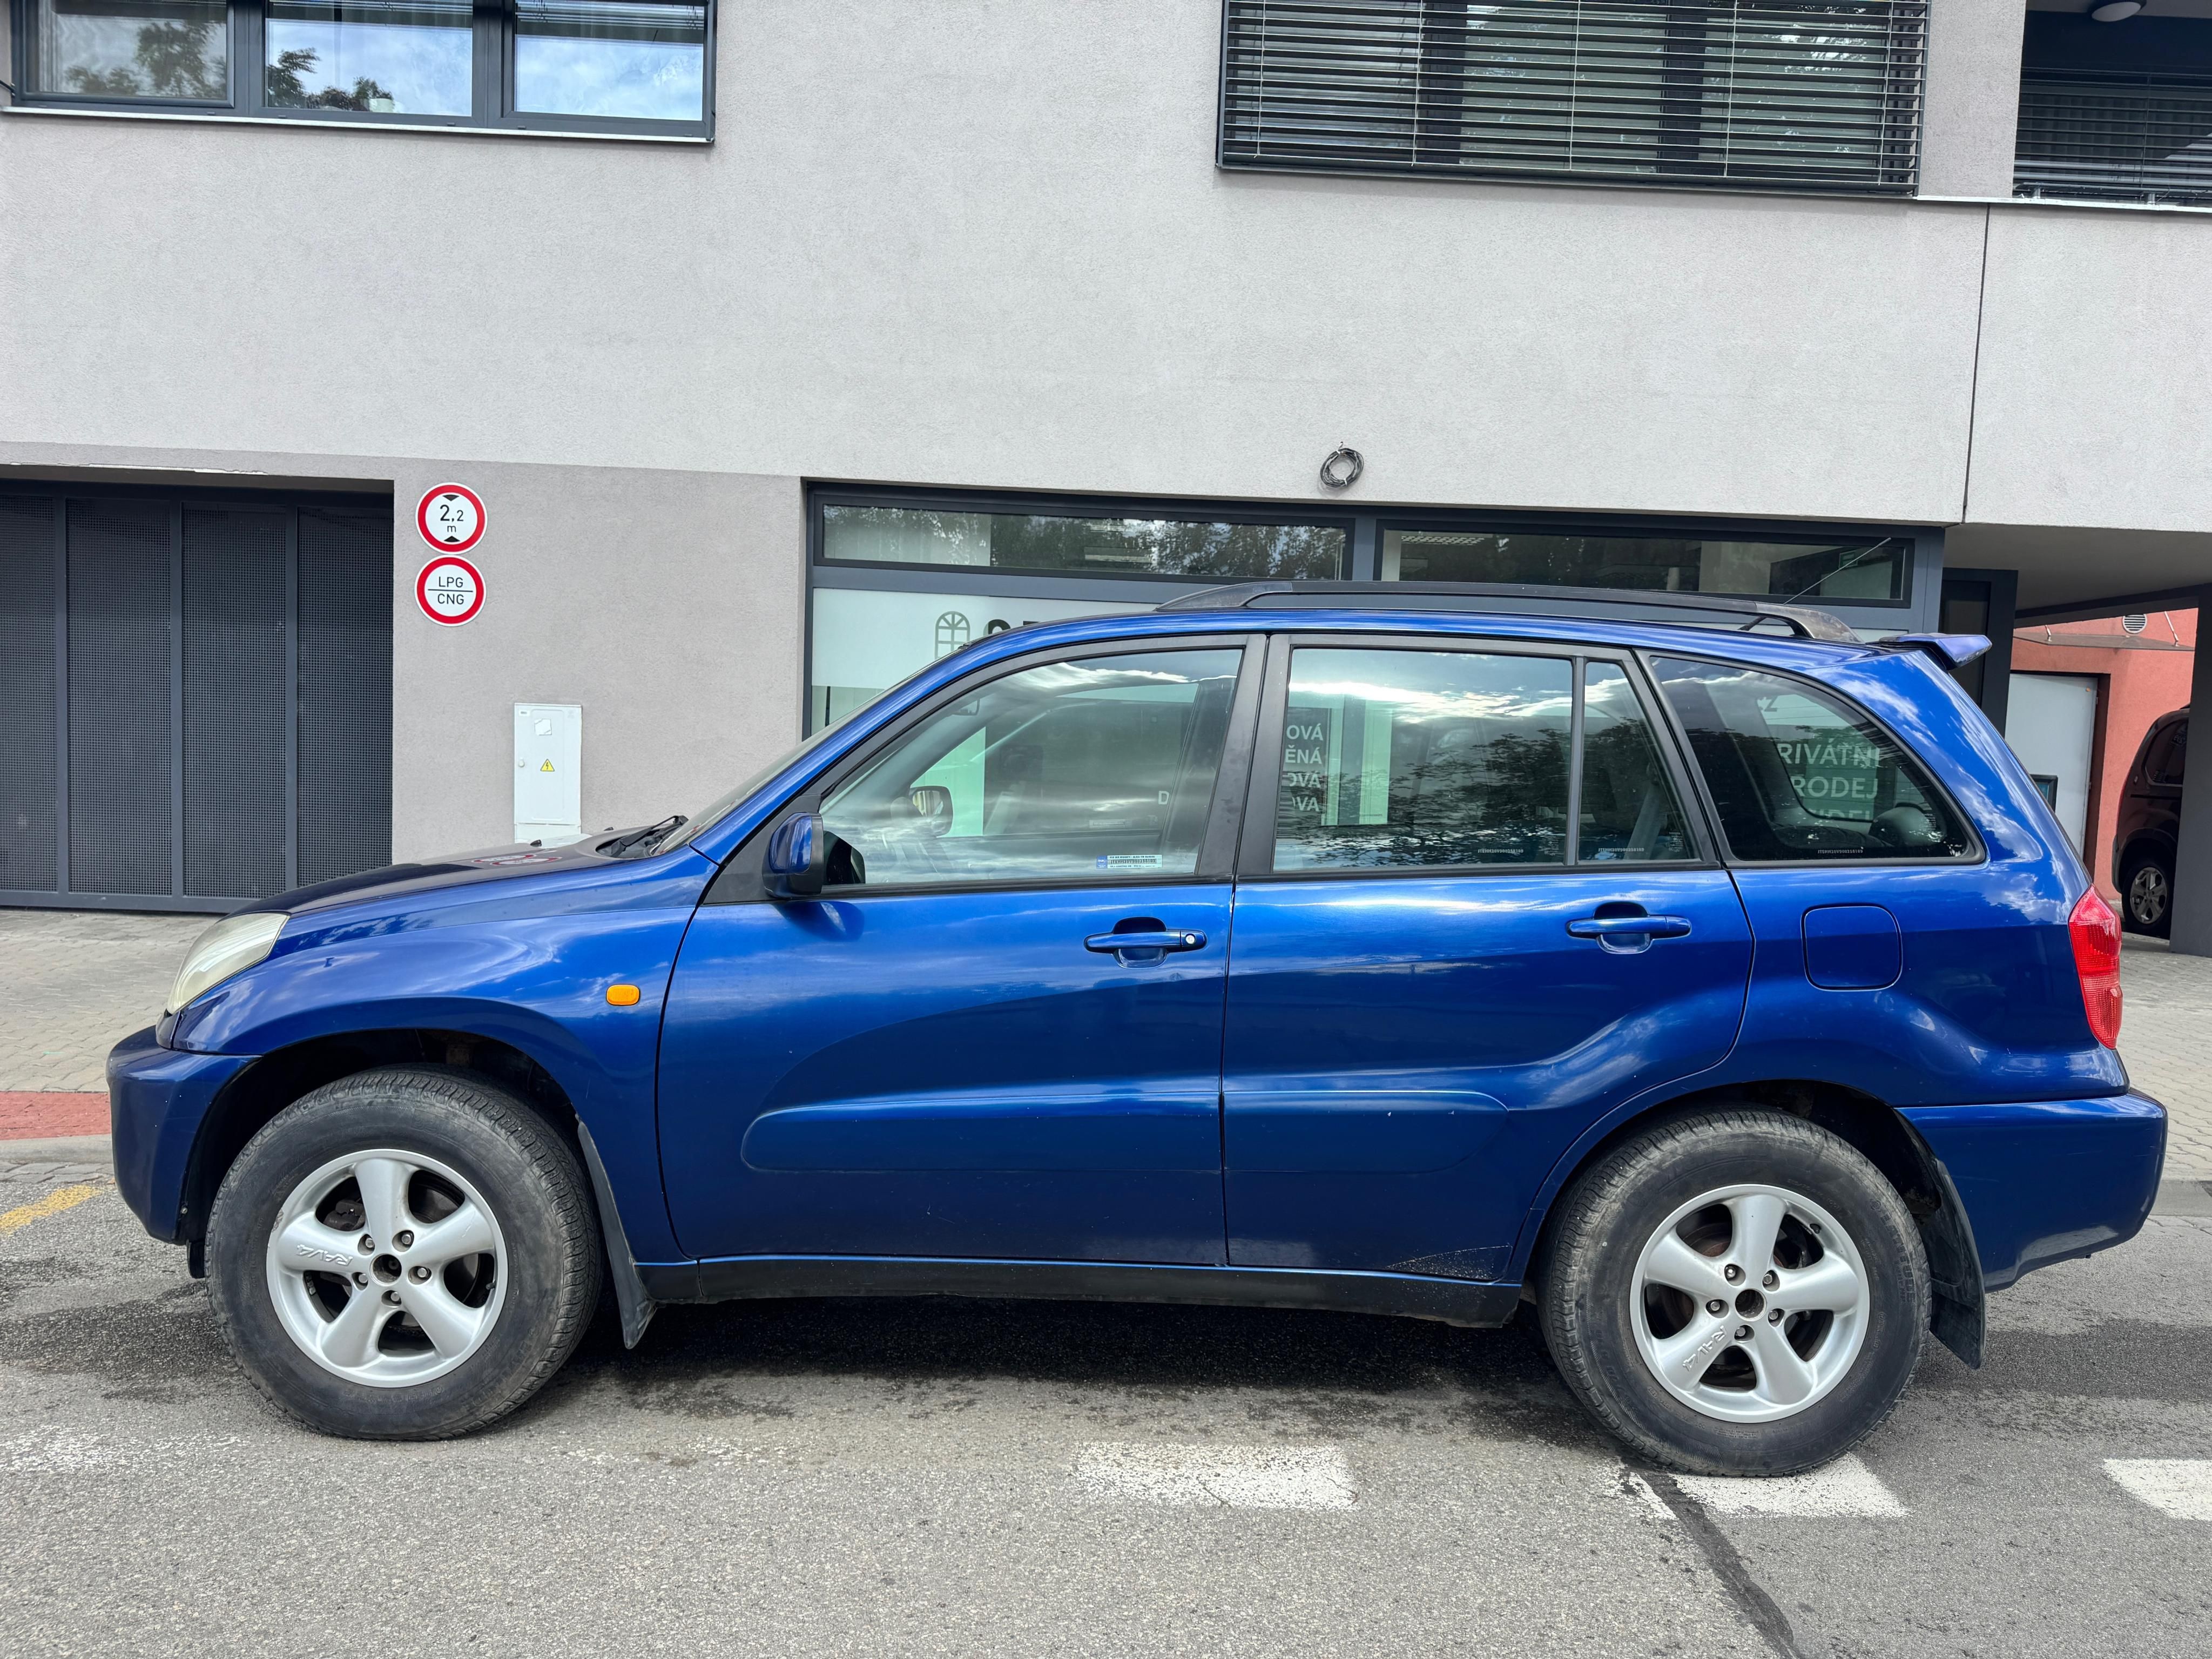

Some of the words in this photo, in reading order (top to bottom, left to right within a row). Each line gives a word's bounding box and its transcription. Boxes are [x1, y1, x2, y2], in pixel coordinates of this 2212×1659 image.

[440, 504, 464, 522] 2,2
[438, 576, 463, 588] LPG
[437, 593, 464, 605] CNG
[1286, 723, 1324, 741] OVÁ
[1285, 745, 1323, 764] ĚNÁ
[1158, 790, 1170, 805] D
[1292, 797, 1320, 812] VA
[296, 1244, 353, 1266] RAV4
[1682, 1325, 1727, 1372] RAV4
